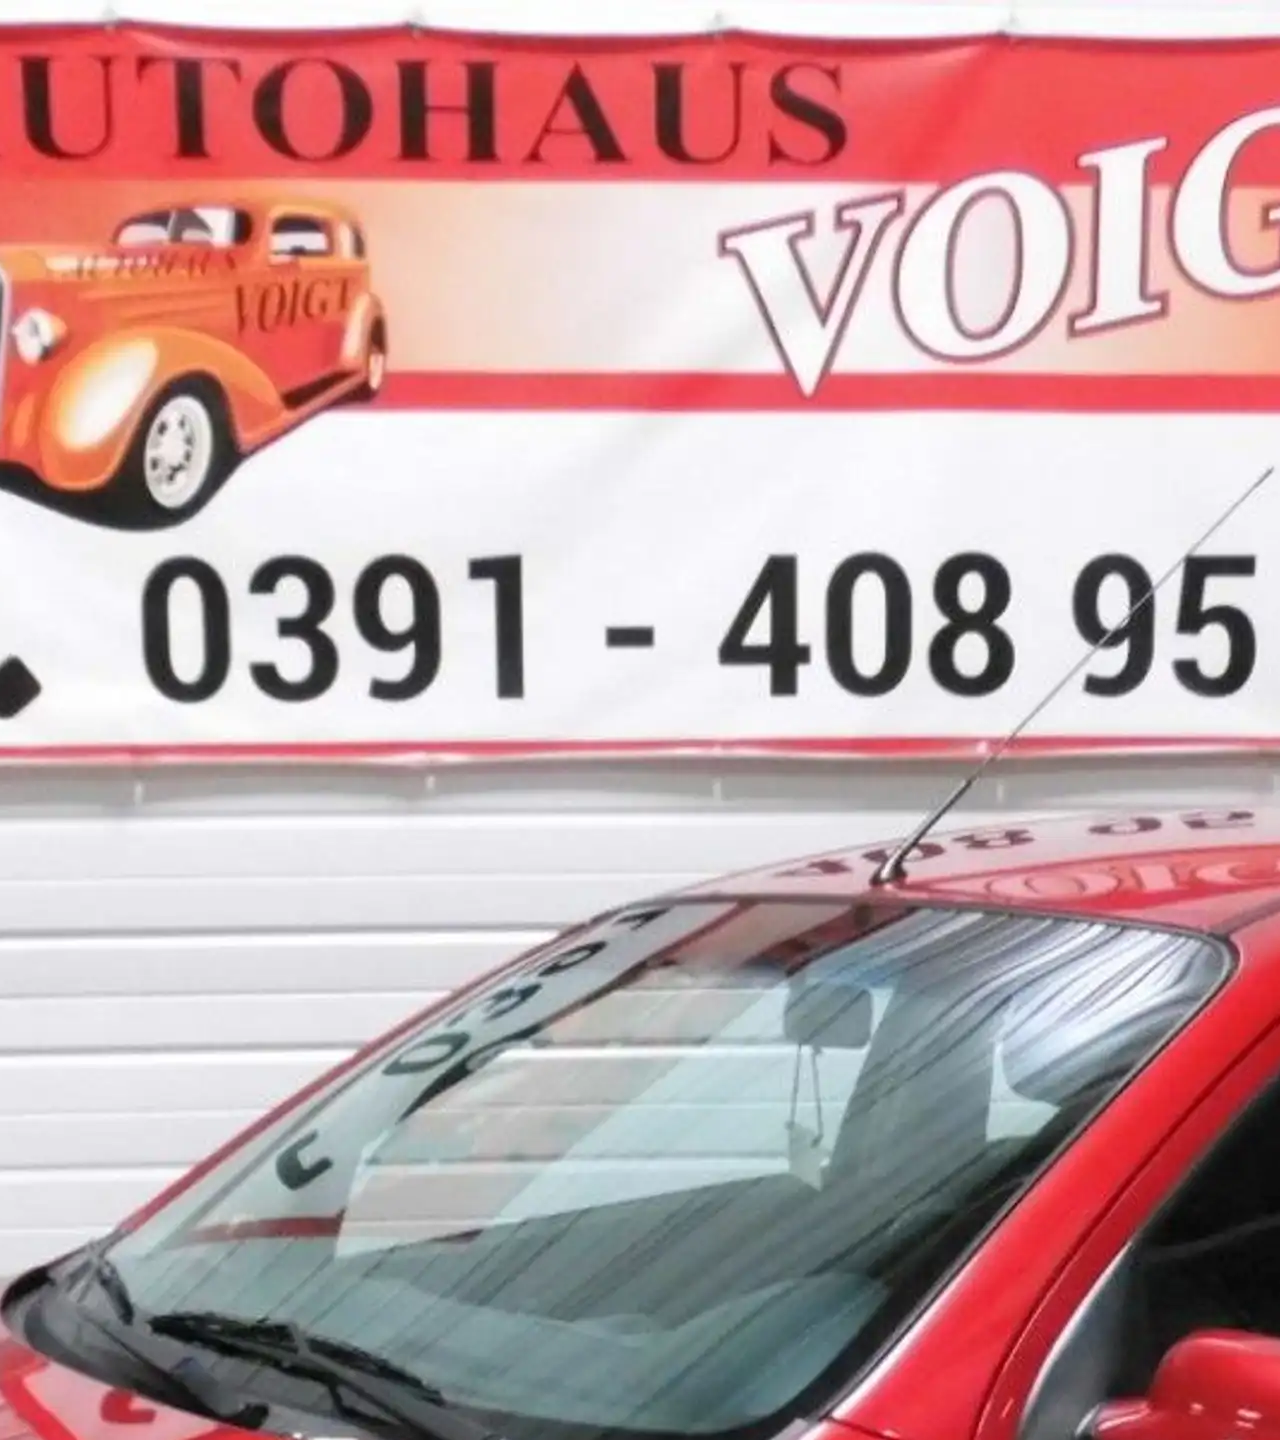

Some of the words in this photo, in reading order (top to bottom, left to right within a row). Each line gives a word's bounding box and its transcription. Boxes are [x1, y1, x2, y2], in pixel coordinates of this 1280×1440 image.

[234, 272, 355, 335] VOIGT
[141, 553, 525, 704] 0391
[606, 626, 655, 648] -
[718, 551, 1017, 698] 408
[1071, 552, 1258, 698] 95
